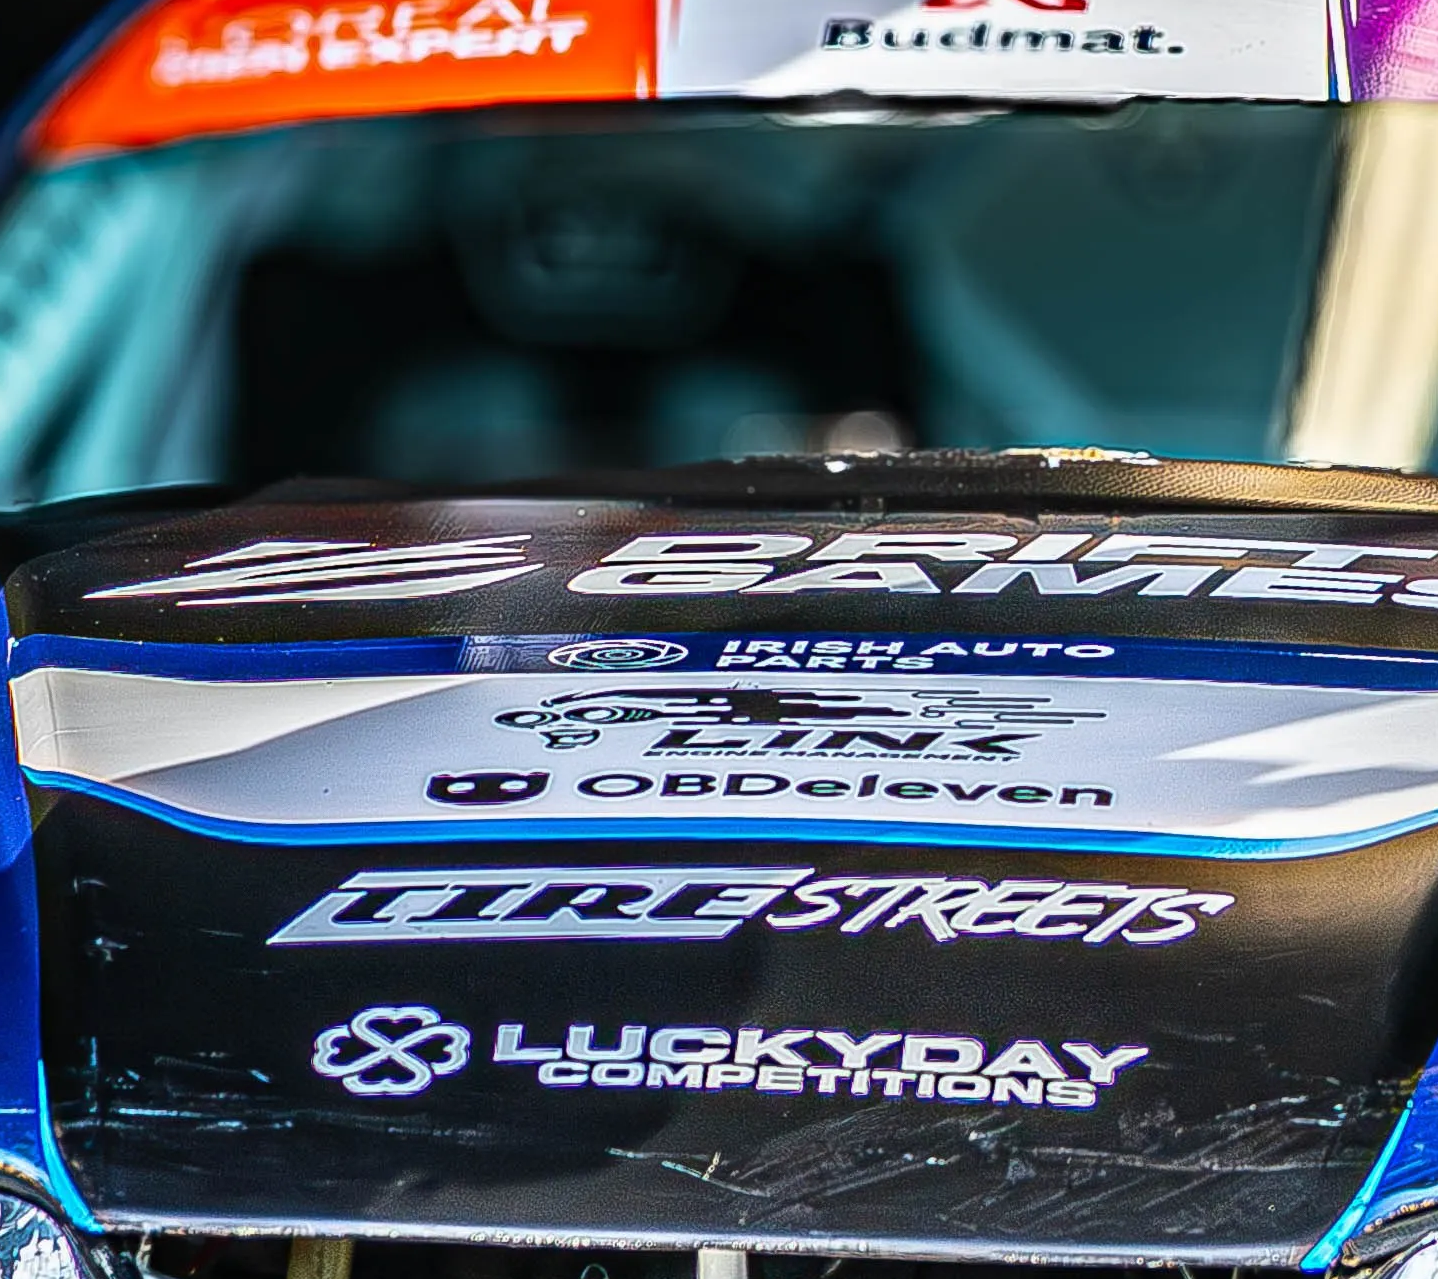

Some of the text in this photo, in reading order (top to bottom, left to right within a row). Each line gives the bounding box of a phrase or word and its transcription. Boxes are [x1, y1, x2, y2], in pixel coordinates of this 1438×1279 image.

[715, 654, 934, 669] PARTS
[723, 640, 1116, 659] IRISH AUTO
[652, 728, 1042, 755] LINK
[779, 751, 1020, 761] MANAGEMENT
[578, 773, 1114, 807] OBDeleven
[493, 1024, 1149, 1083] LUCKYDAY
[538, 1062, 1097, 1105] COMPETITIONS
